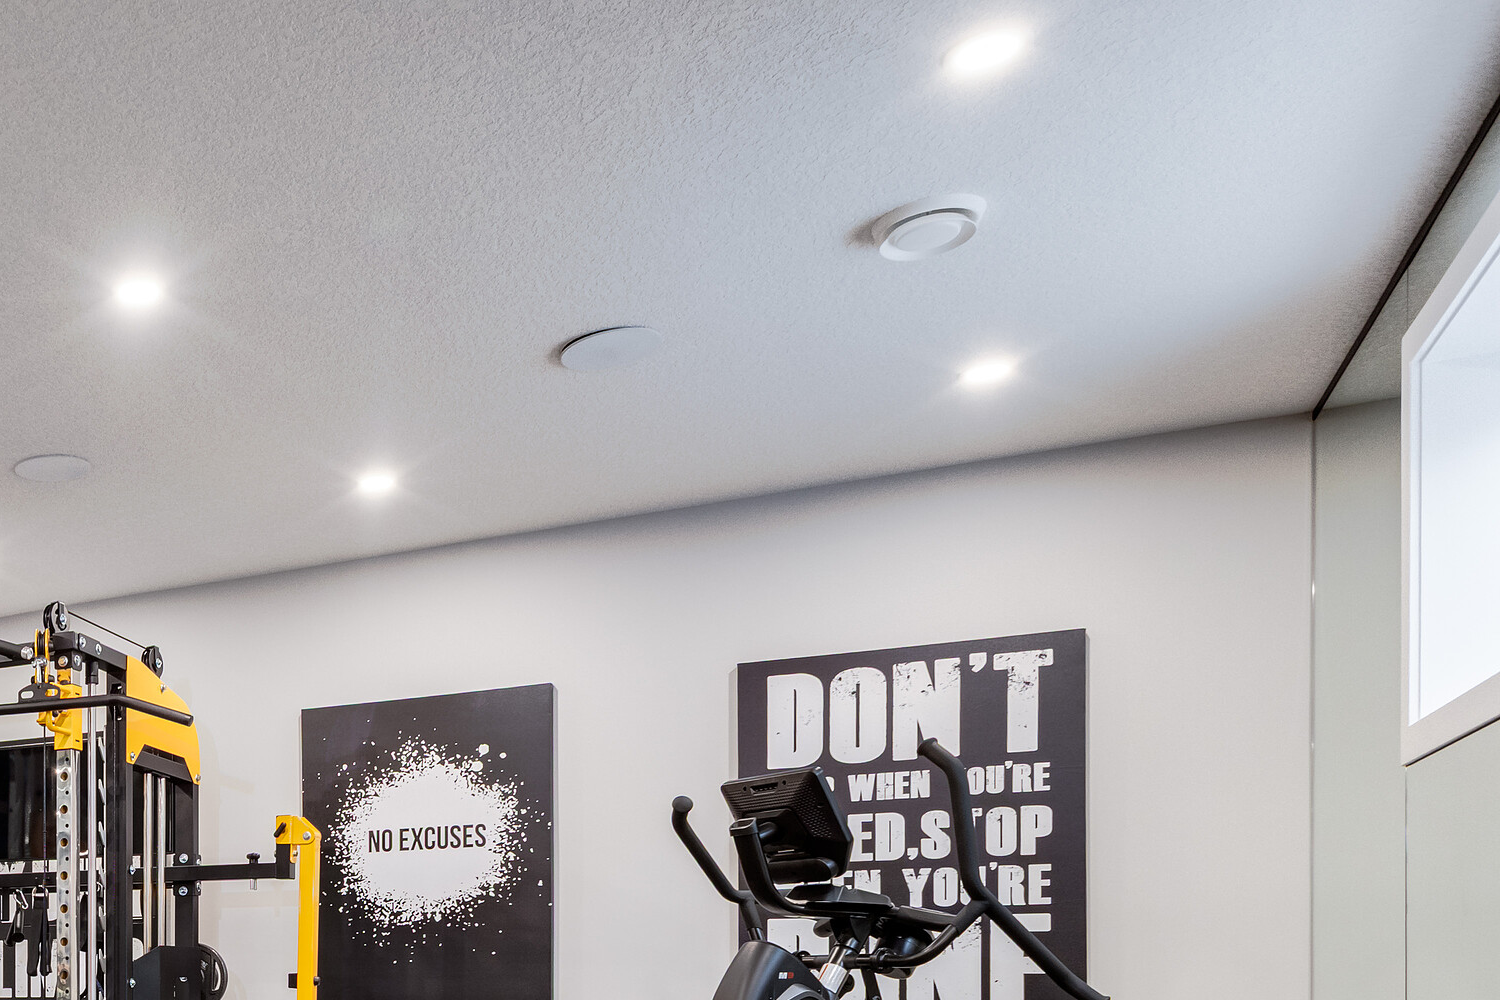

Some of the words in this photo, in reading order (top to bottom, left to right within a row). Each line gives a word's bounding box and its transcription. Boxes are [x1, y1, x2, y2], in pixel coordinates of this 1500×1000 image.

[766, 648, 1054, 770] DON'T
[847, 769, 931, 802] WHEN
[964, 760, 1051, 795] OU'RE
[368, 829, 393, 853] NO
[399, 824, 486, 852] EXCUSES
